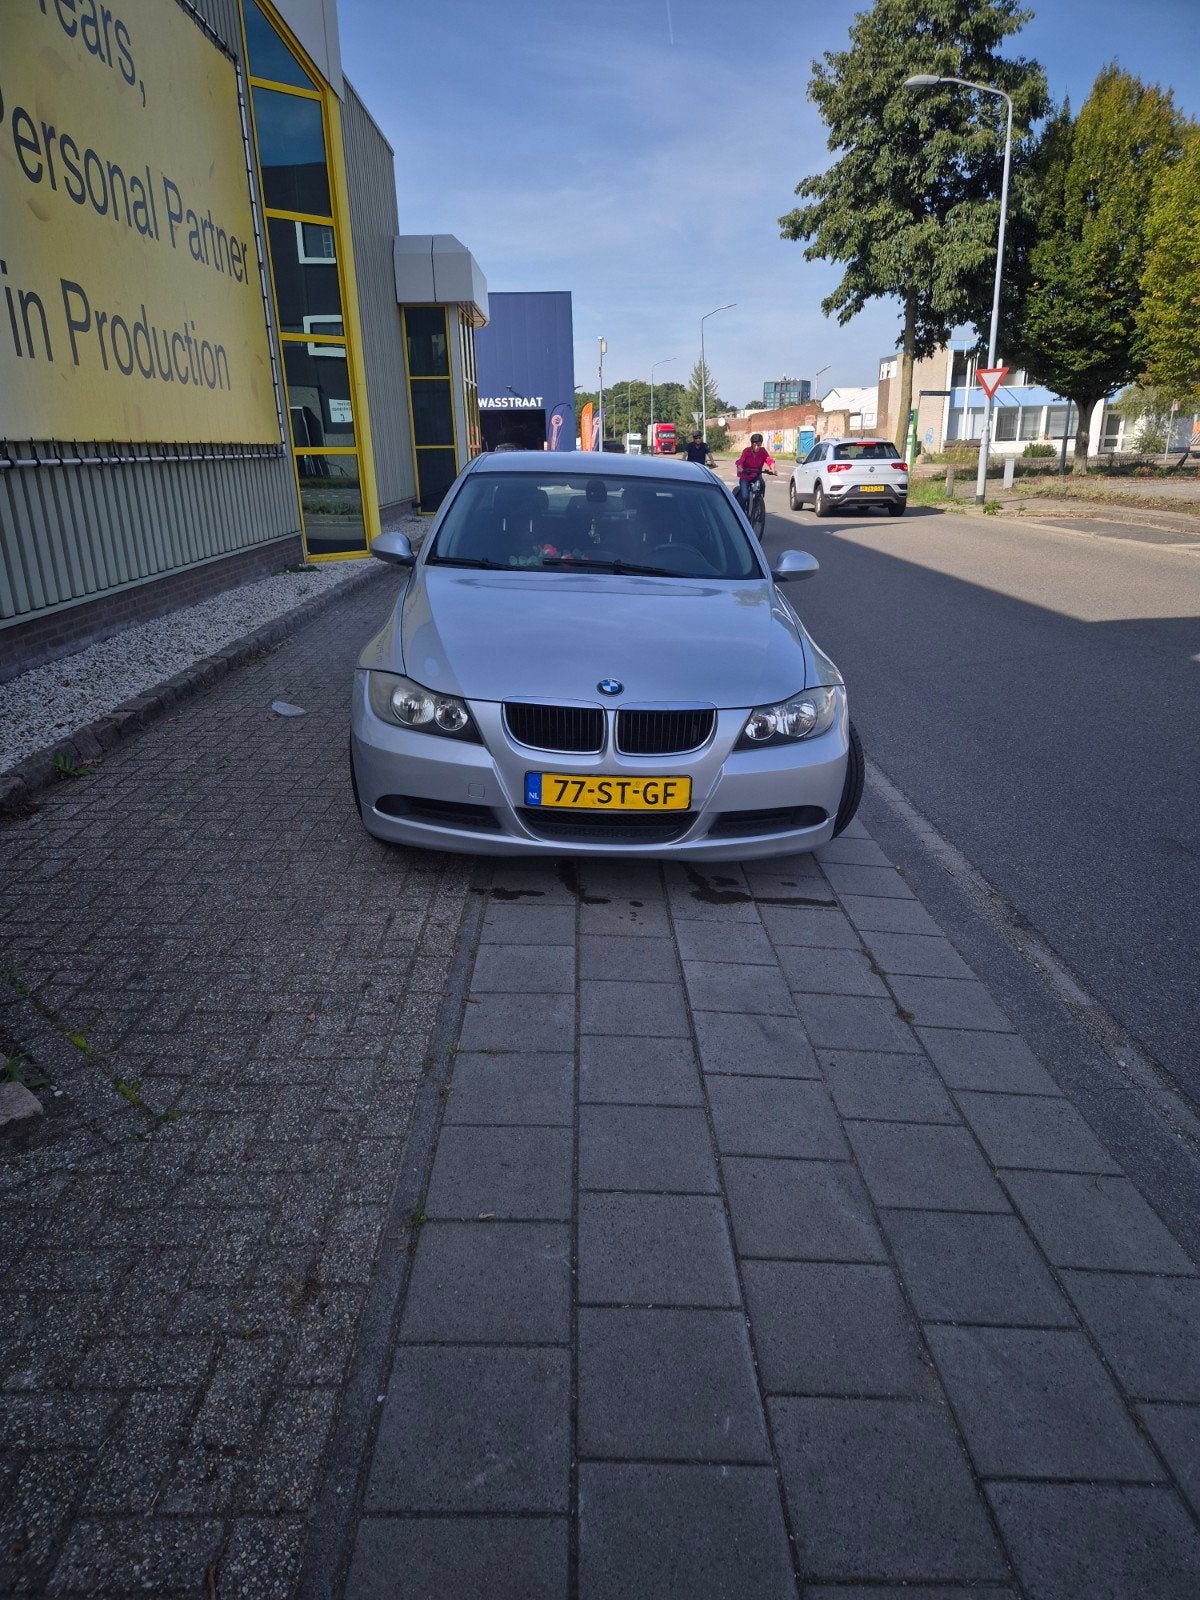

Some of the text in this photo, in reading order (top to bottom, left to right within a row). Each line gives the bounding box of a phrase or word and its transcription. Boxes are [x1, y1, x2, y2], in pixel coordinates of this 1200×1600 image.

[39, 0, 146, 108] ears,
[0, 85, 249, 285] ersonal Partner
[0, 259, 231, 391] in Production
[477, 397, 543, 408] WASSTRAAT
[528, 791, 540, 800] NL
[554, 779, 677, 805] 77-ST-GF
